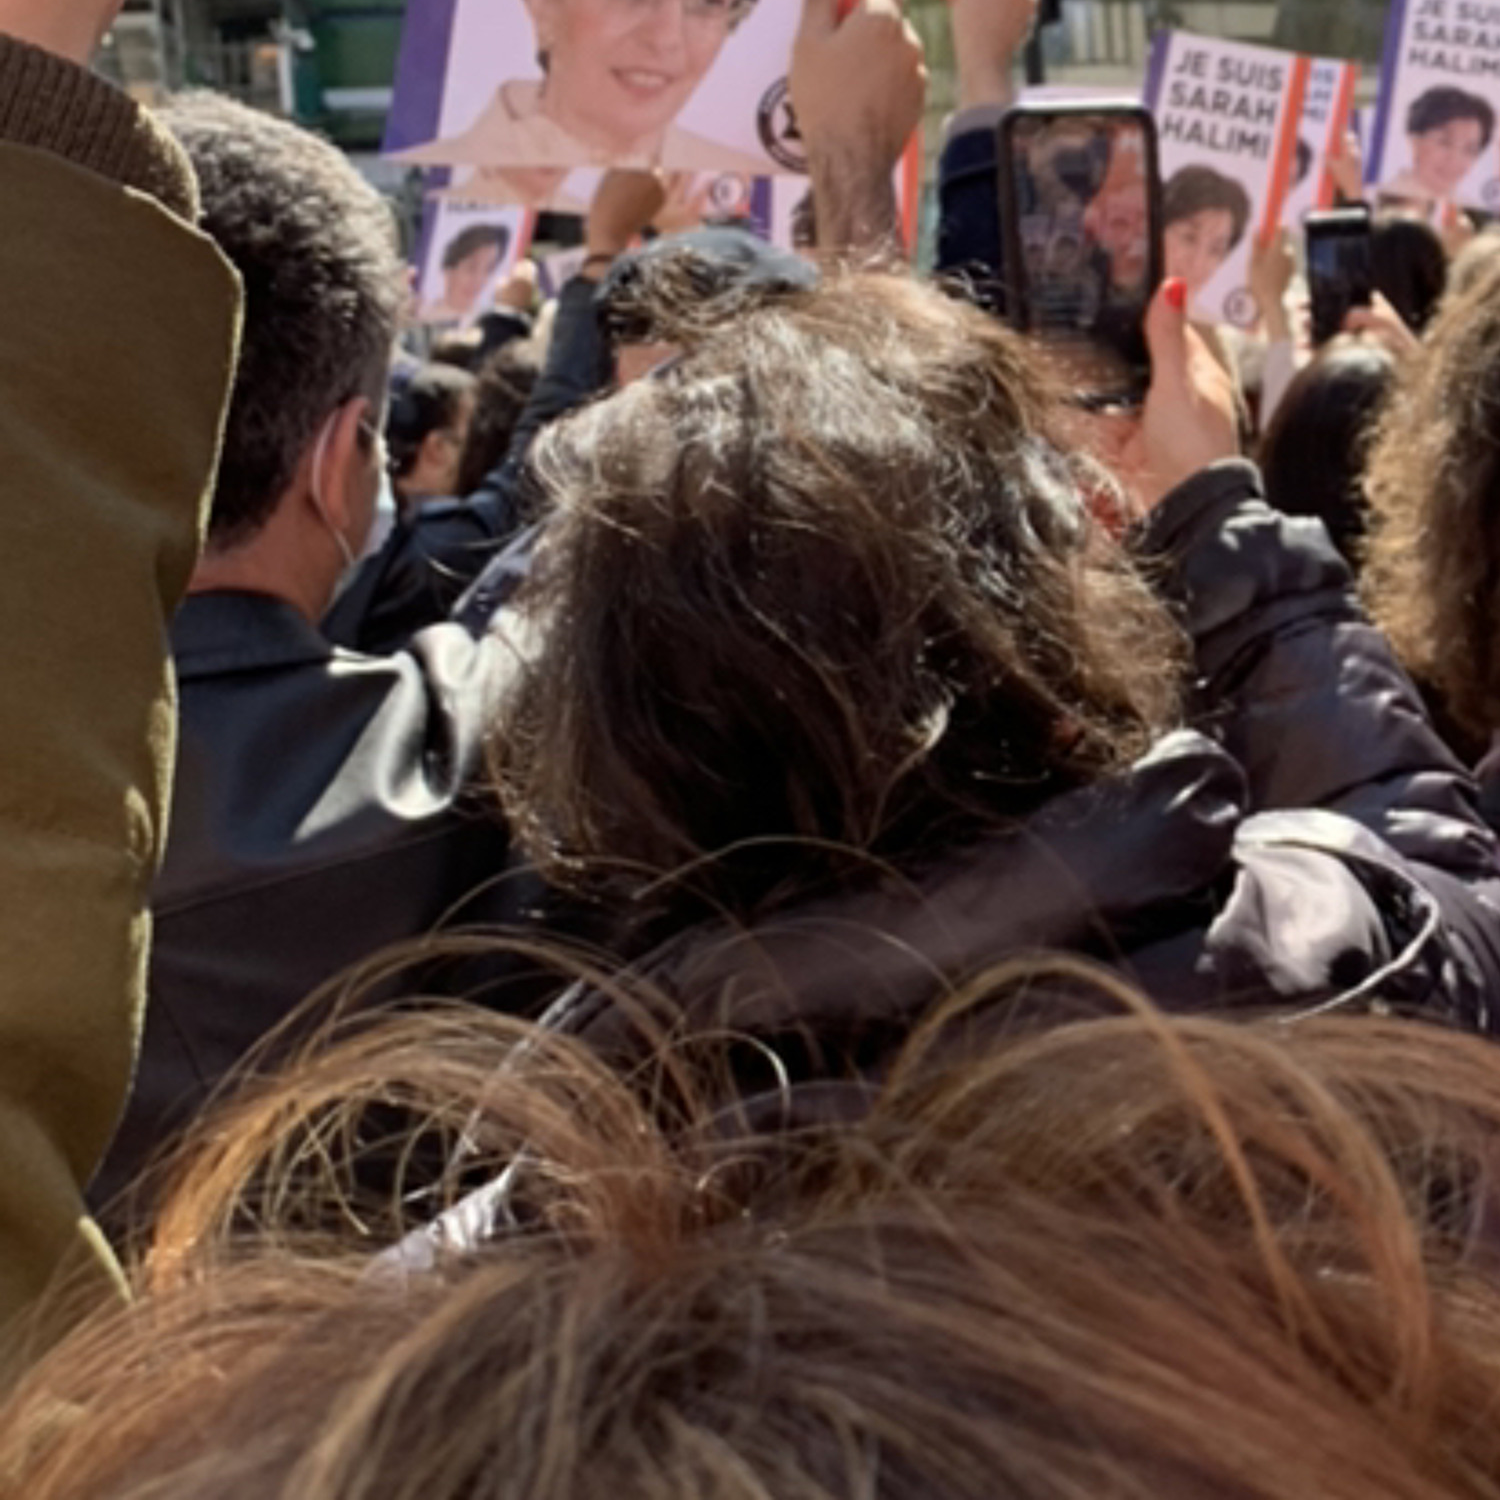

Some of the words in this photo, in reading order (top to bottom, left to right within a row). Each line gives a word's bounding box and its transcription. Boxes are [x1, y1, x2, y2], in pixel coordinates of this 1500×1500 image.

[1175, 50, 1209, 78] JE
[1217, 56, 1283, 92] SUIS
[1168, 80, 1279, 126] SARAH
[1161, 113, 1271, 161] HALIMI
